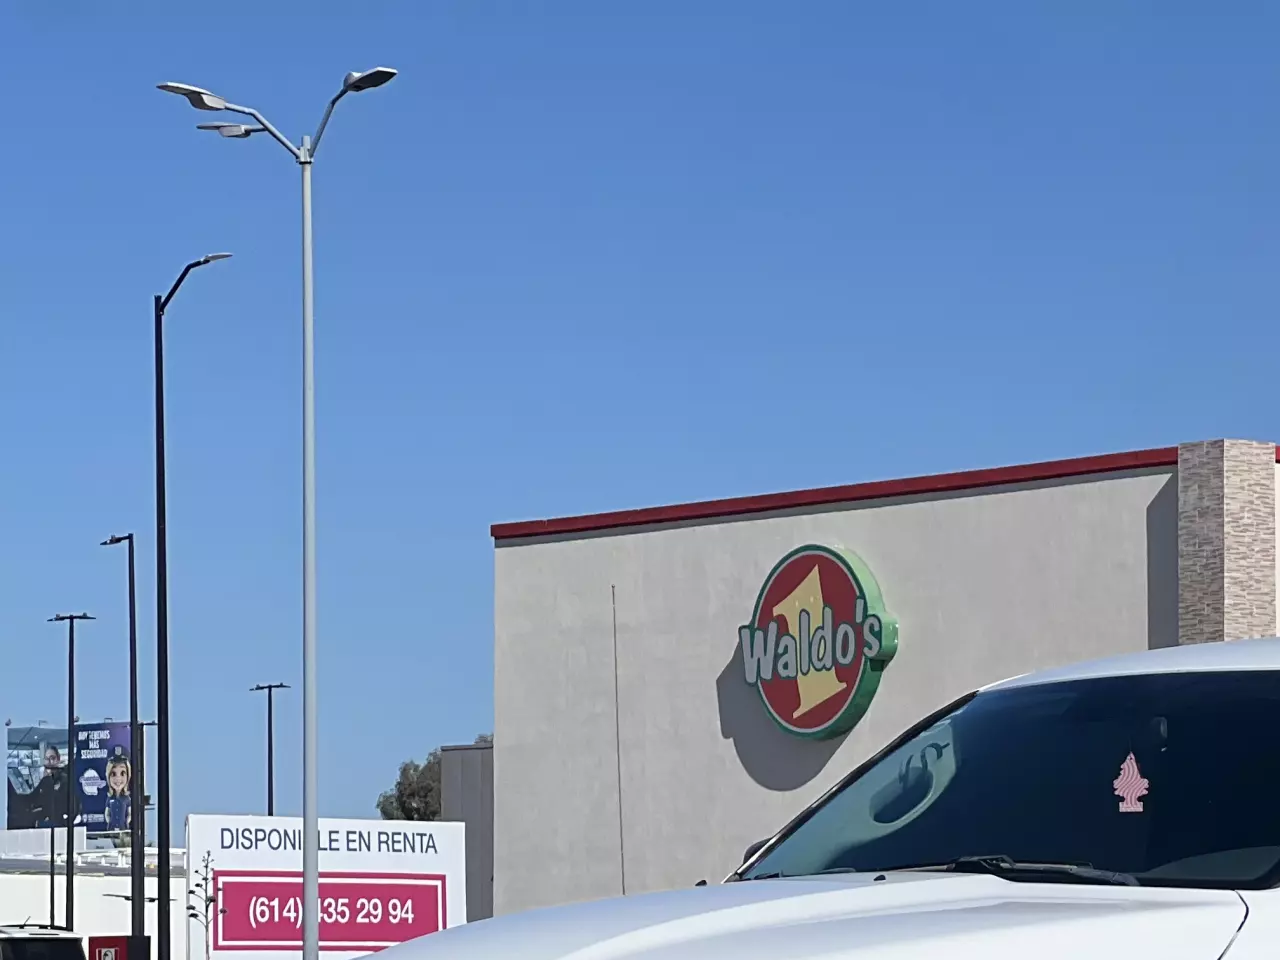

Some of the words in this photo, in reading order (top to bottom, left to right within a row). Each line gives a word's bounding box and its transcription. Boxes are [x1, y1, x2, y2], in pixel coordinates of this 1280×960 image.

[739, 596, 883, 685] Waldo's
[220, 828, 340, 851] DISPONILE
[346, 830, 371, 851] EN
[378, 832, 438, 853] RENTA
[249, 896, 302, 928] (614)
[356, 899, 383, 923] 29
[388, 899, 414, 924] 94
